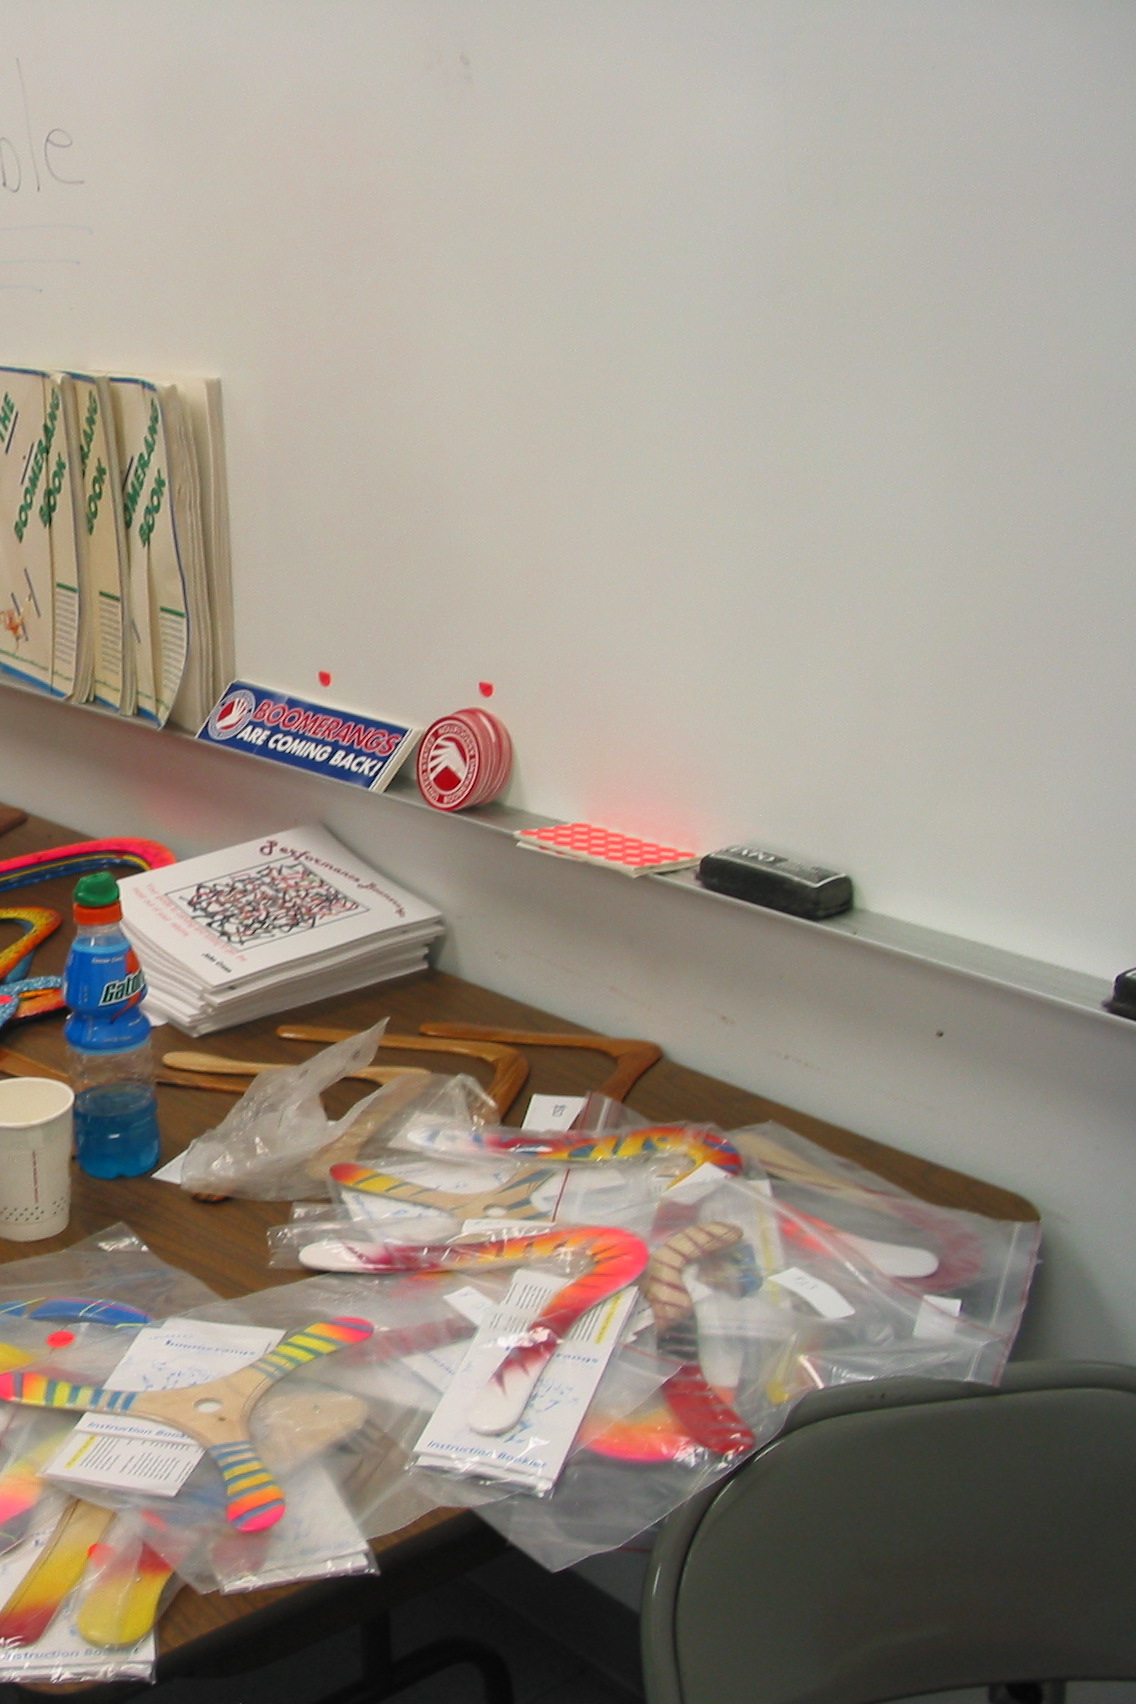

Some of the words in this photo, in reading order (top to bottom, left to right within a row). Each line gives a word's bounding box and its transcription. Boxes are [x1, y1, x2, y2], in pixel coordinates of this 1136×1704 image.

[14, 386, 61, 544] BOOMERANG
[39, 451, 66, 528] BOOK
[139, 467, 165, 549] BOOK
[236, 725, 267, 745] ARE
[268, 732, 333, 762] COMING
[329, 749, 384, 778] BACK!
[252, 700, 403, 757] BOOMERANGS
